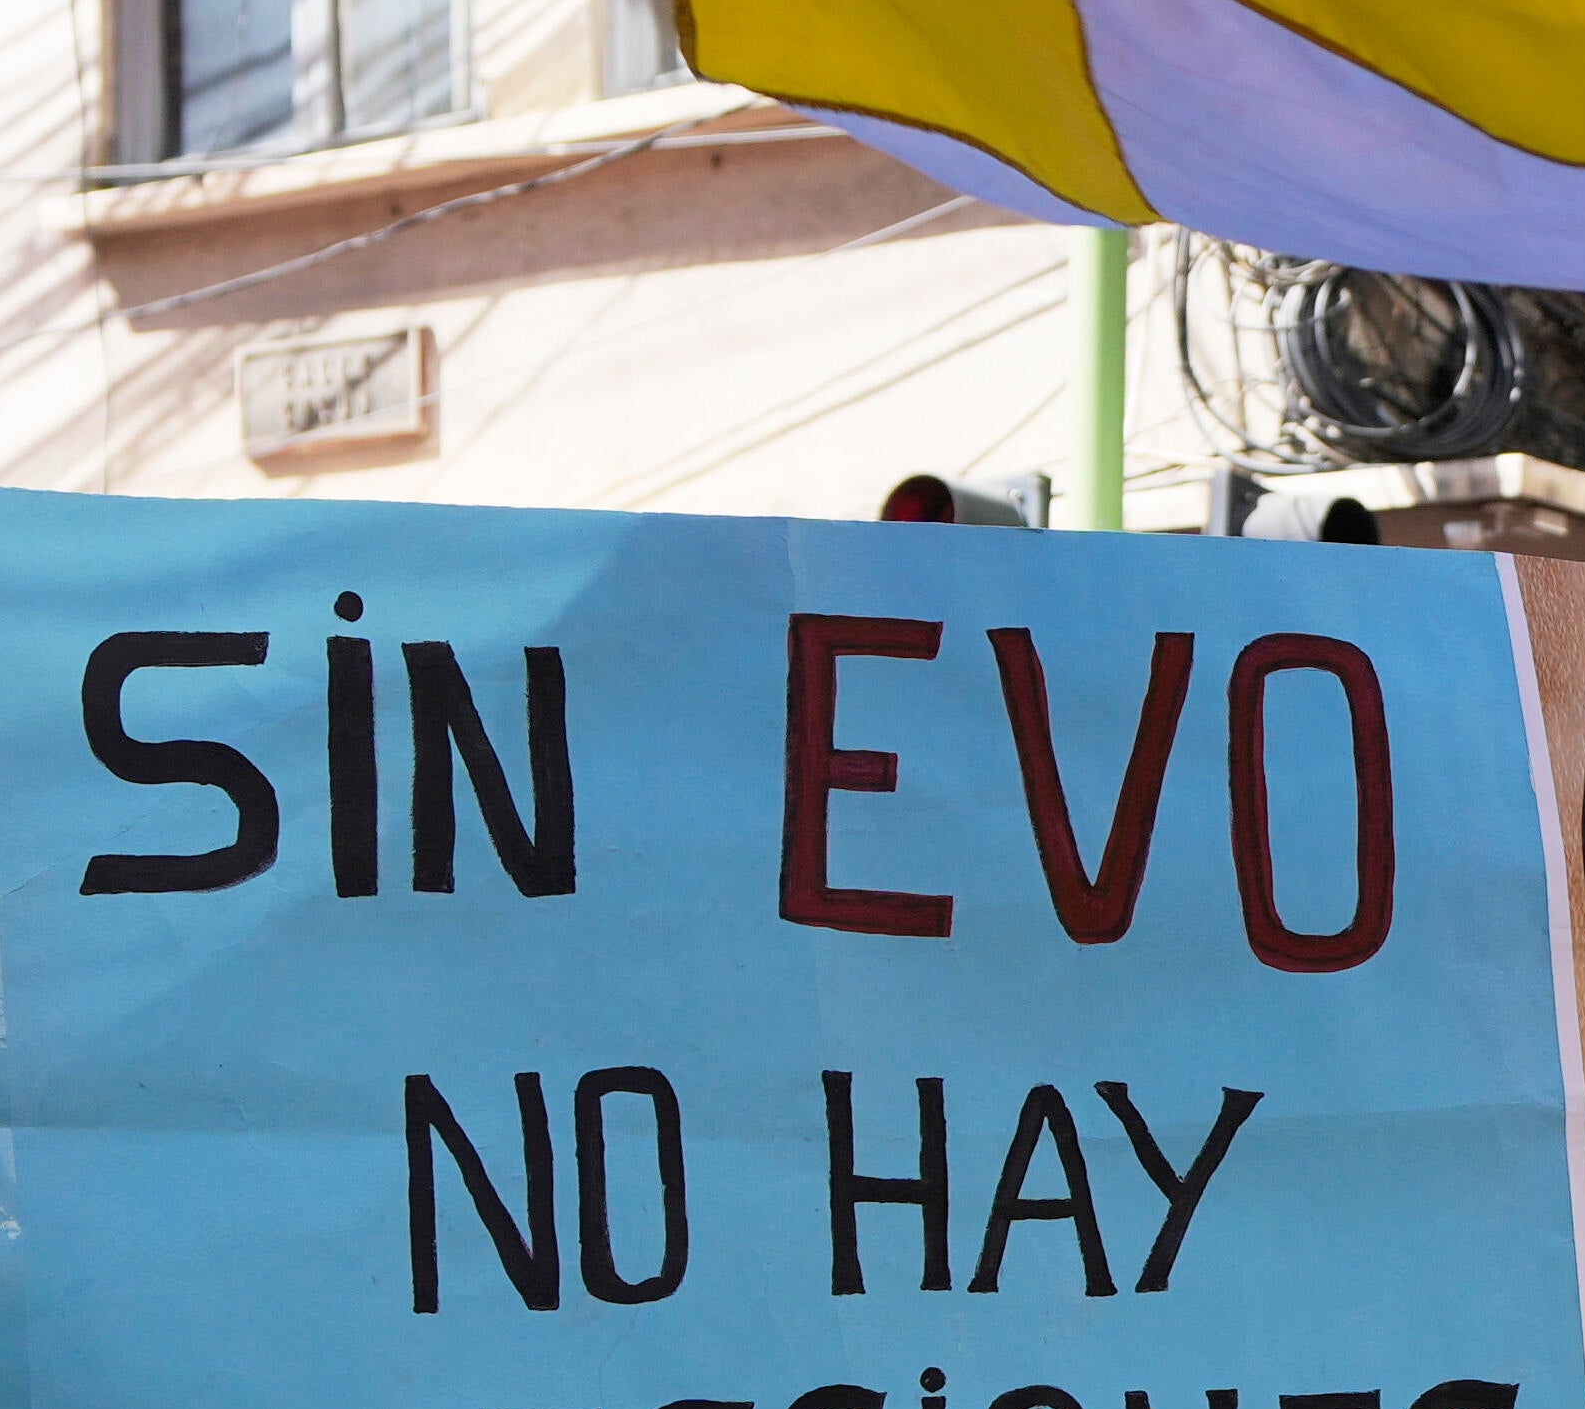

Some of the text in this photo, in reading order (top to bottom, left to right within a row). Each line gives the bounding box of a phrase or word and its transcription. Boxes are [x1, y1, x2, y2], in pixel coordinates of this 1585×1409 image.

[779, 613, 1395, 973] EVO
[405, 1066, 1264, 1314] NO HAY
